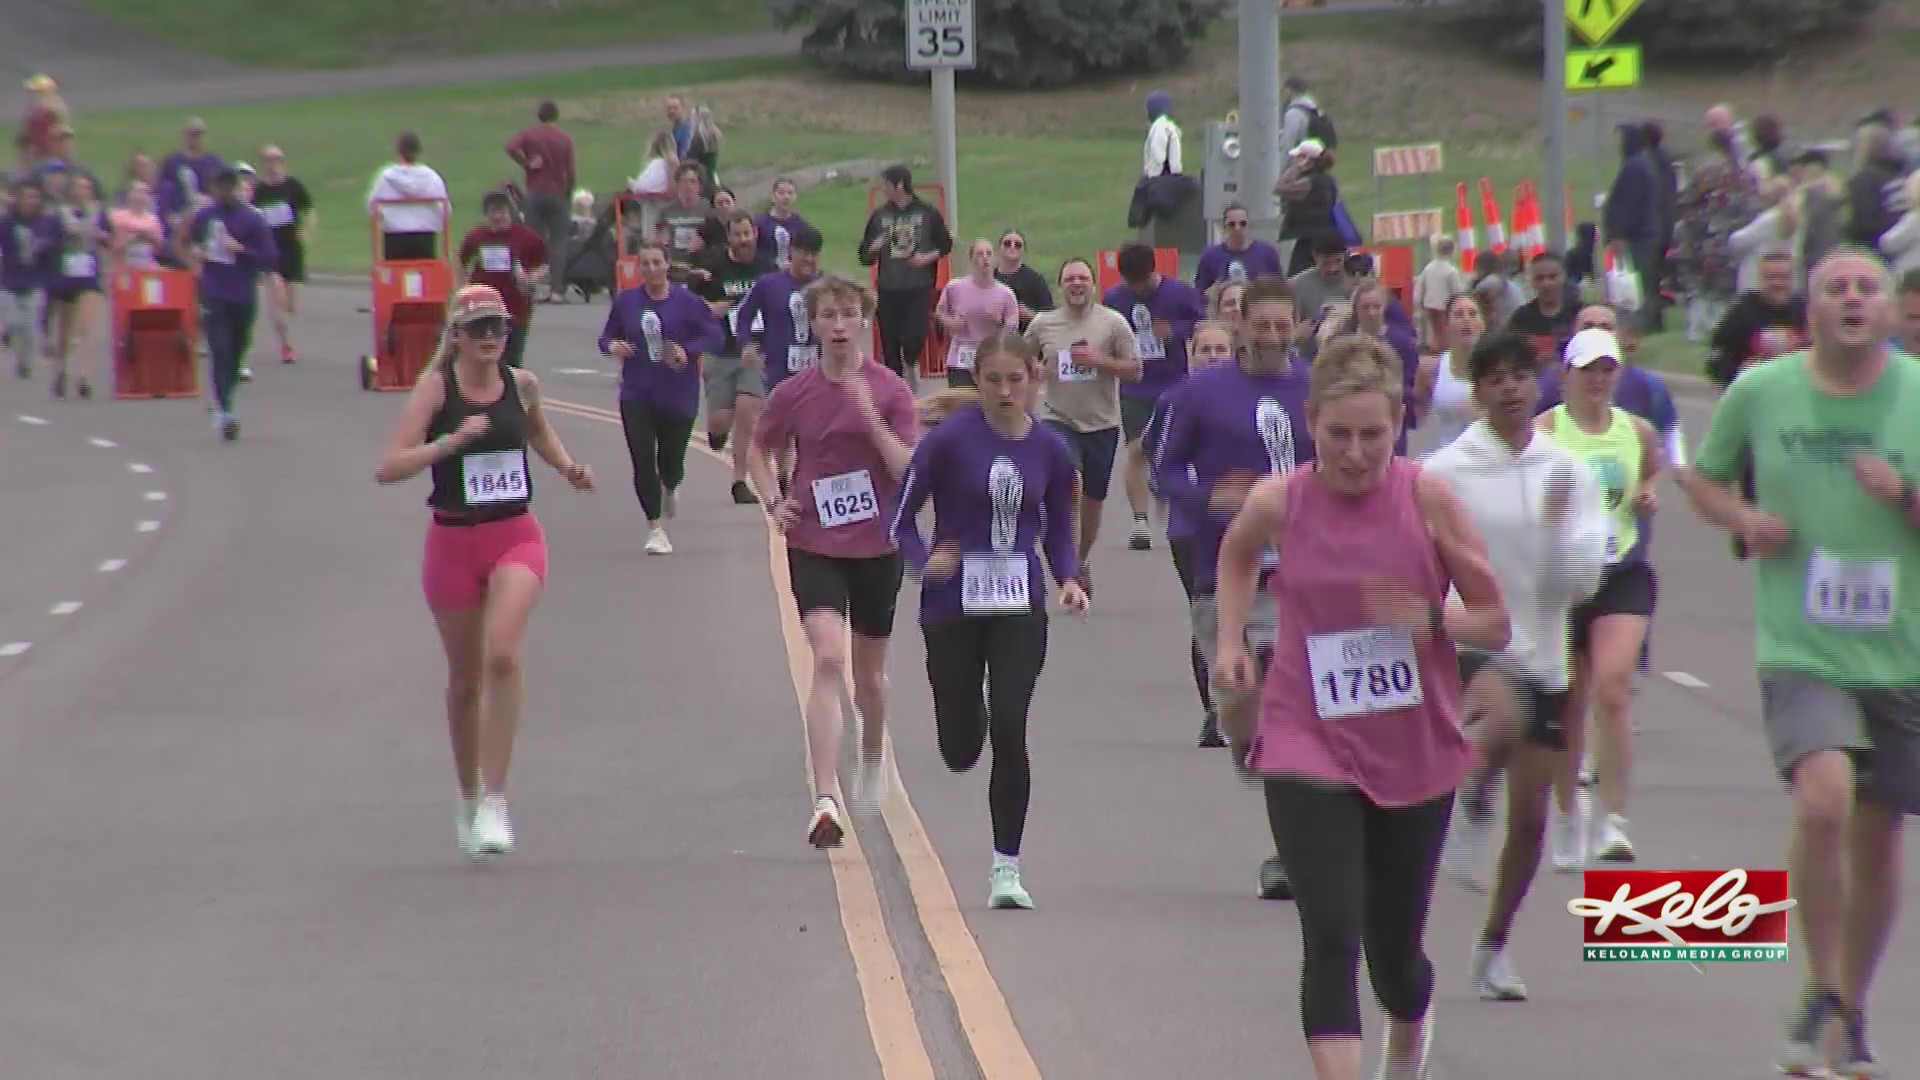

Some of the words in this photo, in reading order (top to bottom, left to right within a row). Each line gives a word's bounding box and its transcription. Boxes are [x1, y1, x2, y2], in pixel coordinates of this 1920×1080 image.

[918, 7, 961, 23] LIMIT
[917, 26, 965, 57] 35
[467, 470, 523, 496] 1845
[821, 491, 873, 519] 1625
[1319, 659, 1413, 705] 1780
